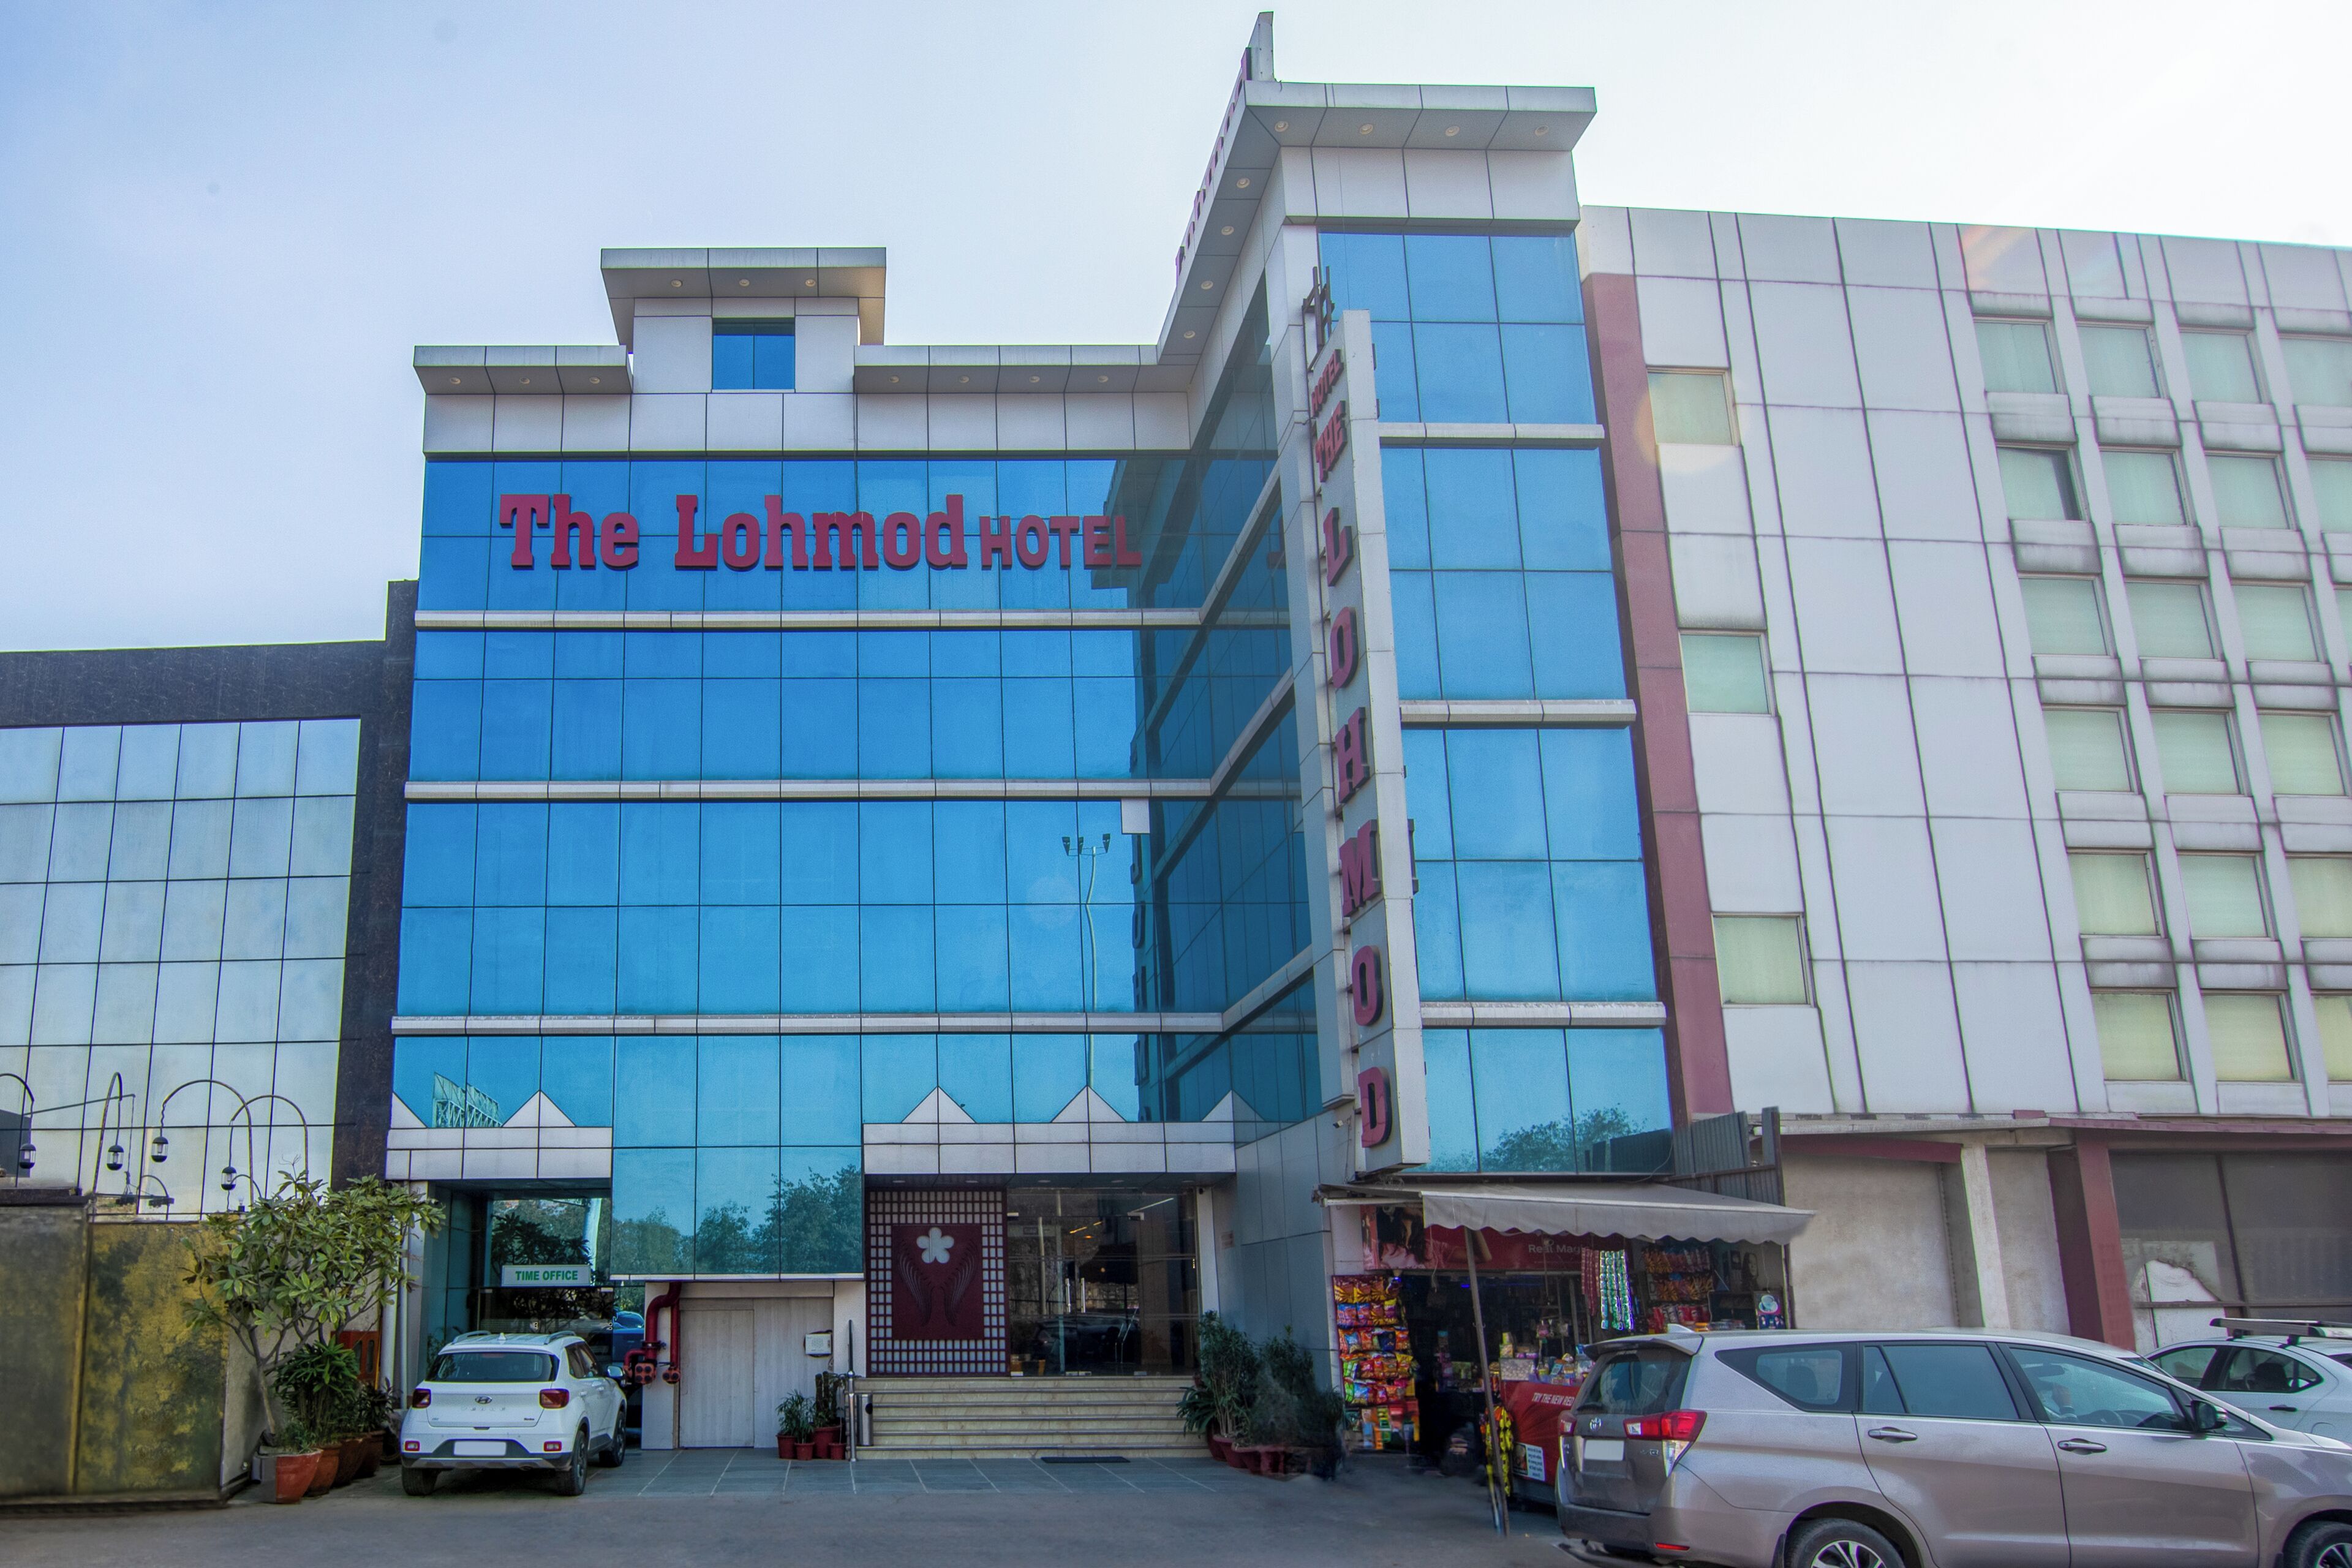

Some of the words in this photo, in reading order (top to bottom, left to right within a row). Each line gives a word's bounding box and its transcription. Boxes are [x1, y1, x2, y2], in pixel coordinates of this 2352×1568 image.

[1311, 349, 1344, 418] HOTEL
[1315, 400, 1348, 483] THE
[499, 494, 638, 570] The
[674, 494, 968, 570] Lohmod
[981, 515, 1142, 570] HOTEL
[1322, 507, 1392, 1149] LOHMOD
[515, 1270, 540, 1281] TIME
[542, 1270, 578, 1281] OFFICE
[1541, 1393, 1553, 1404] THE
[1550, 1394, 1566, 1405] NEW
